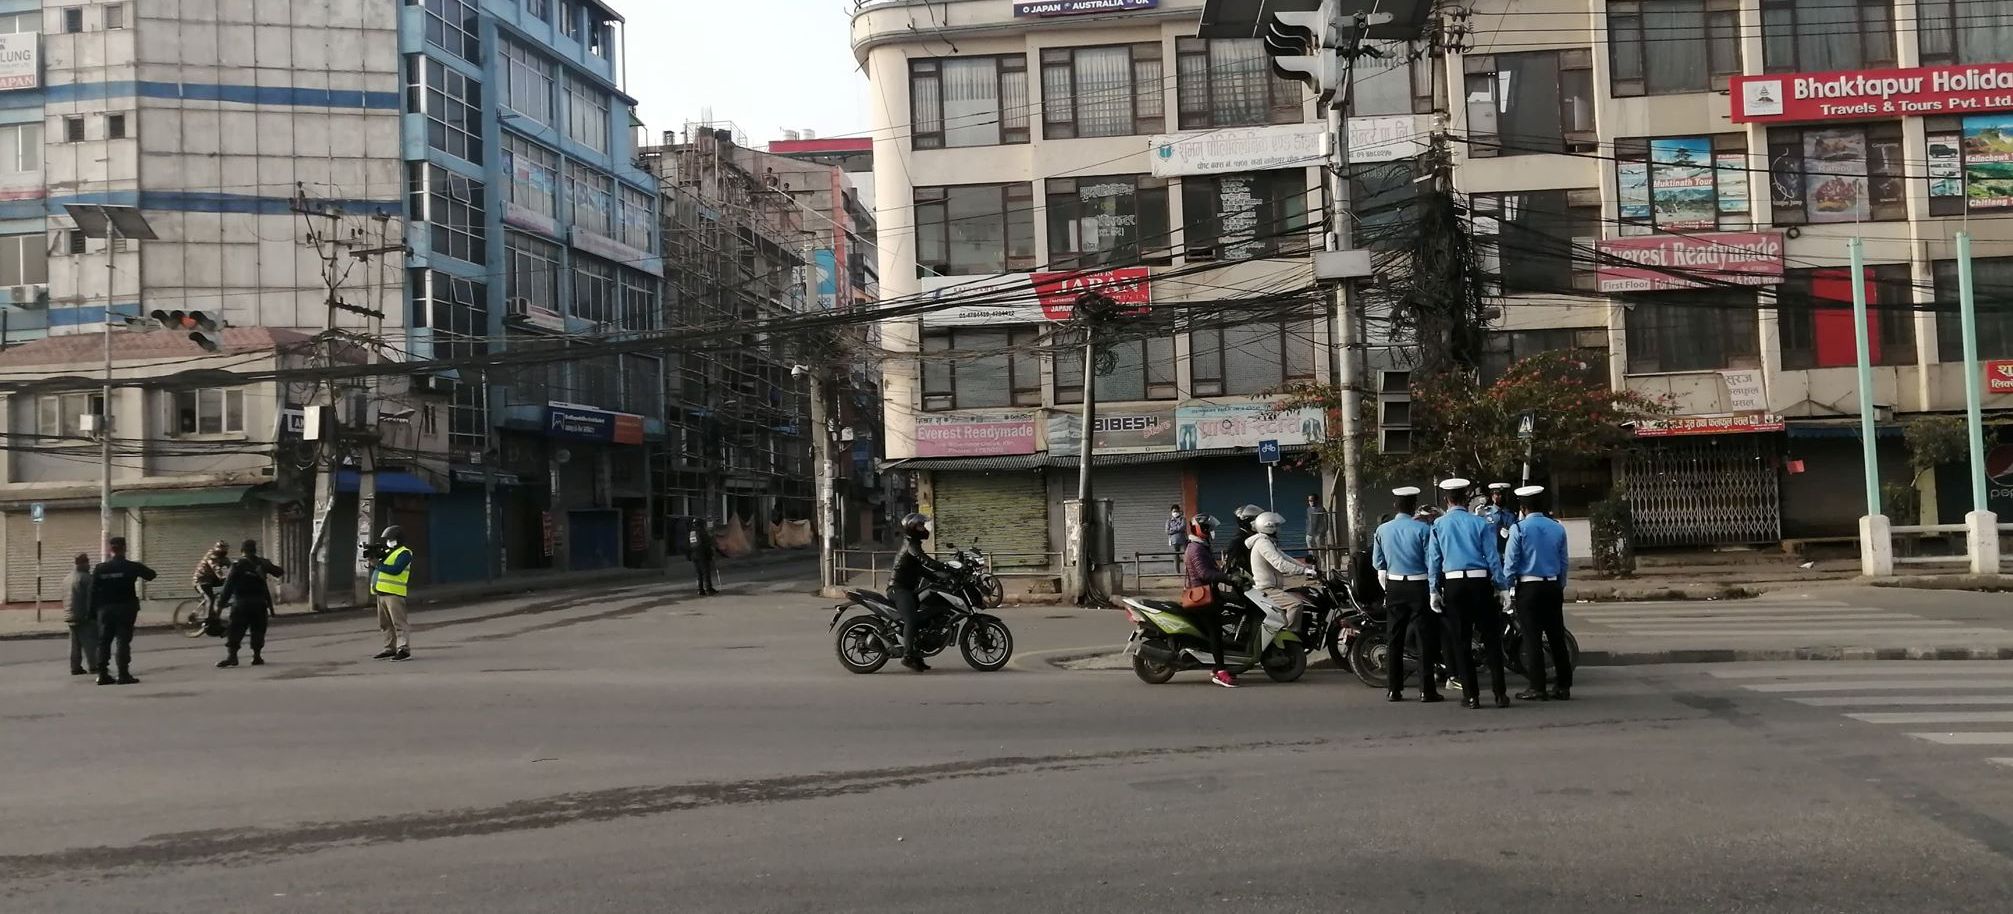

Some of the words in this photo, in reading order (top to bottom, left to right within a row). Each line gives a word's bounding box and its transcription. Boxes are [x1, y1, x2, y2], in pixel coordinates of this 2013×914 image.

[1031, 4, 1061, 13] JAPAN
[1072, 0, 1124, 9] AUSTRALIA
[1794, 75, 1923, 100] Bhaktapur
[1933, 69, 2013, 92] Holida
[1820, 102, 1877, 115] Travels
[1883, 100, 1895, 112] &
[1898, 99, 1942, 112] Tours
[1949, 97, 1980, 109] Pvt.
[1653, 179, 1693, 188] Muktinath
[1694, 178, 1714, 186] Tour
[1600, 243, 1669, 269] Everest
[1673, 237, 1779, 270] Readymade
[1603, 281, 1623, 290] First
[1625, 280, 1650, 289] Floor
[918, 427, 961, 440] Everest
[964, 424, 1033, 440] Readymade
